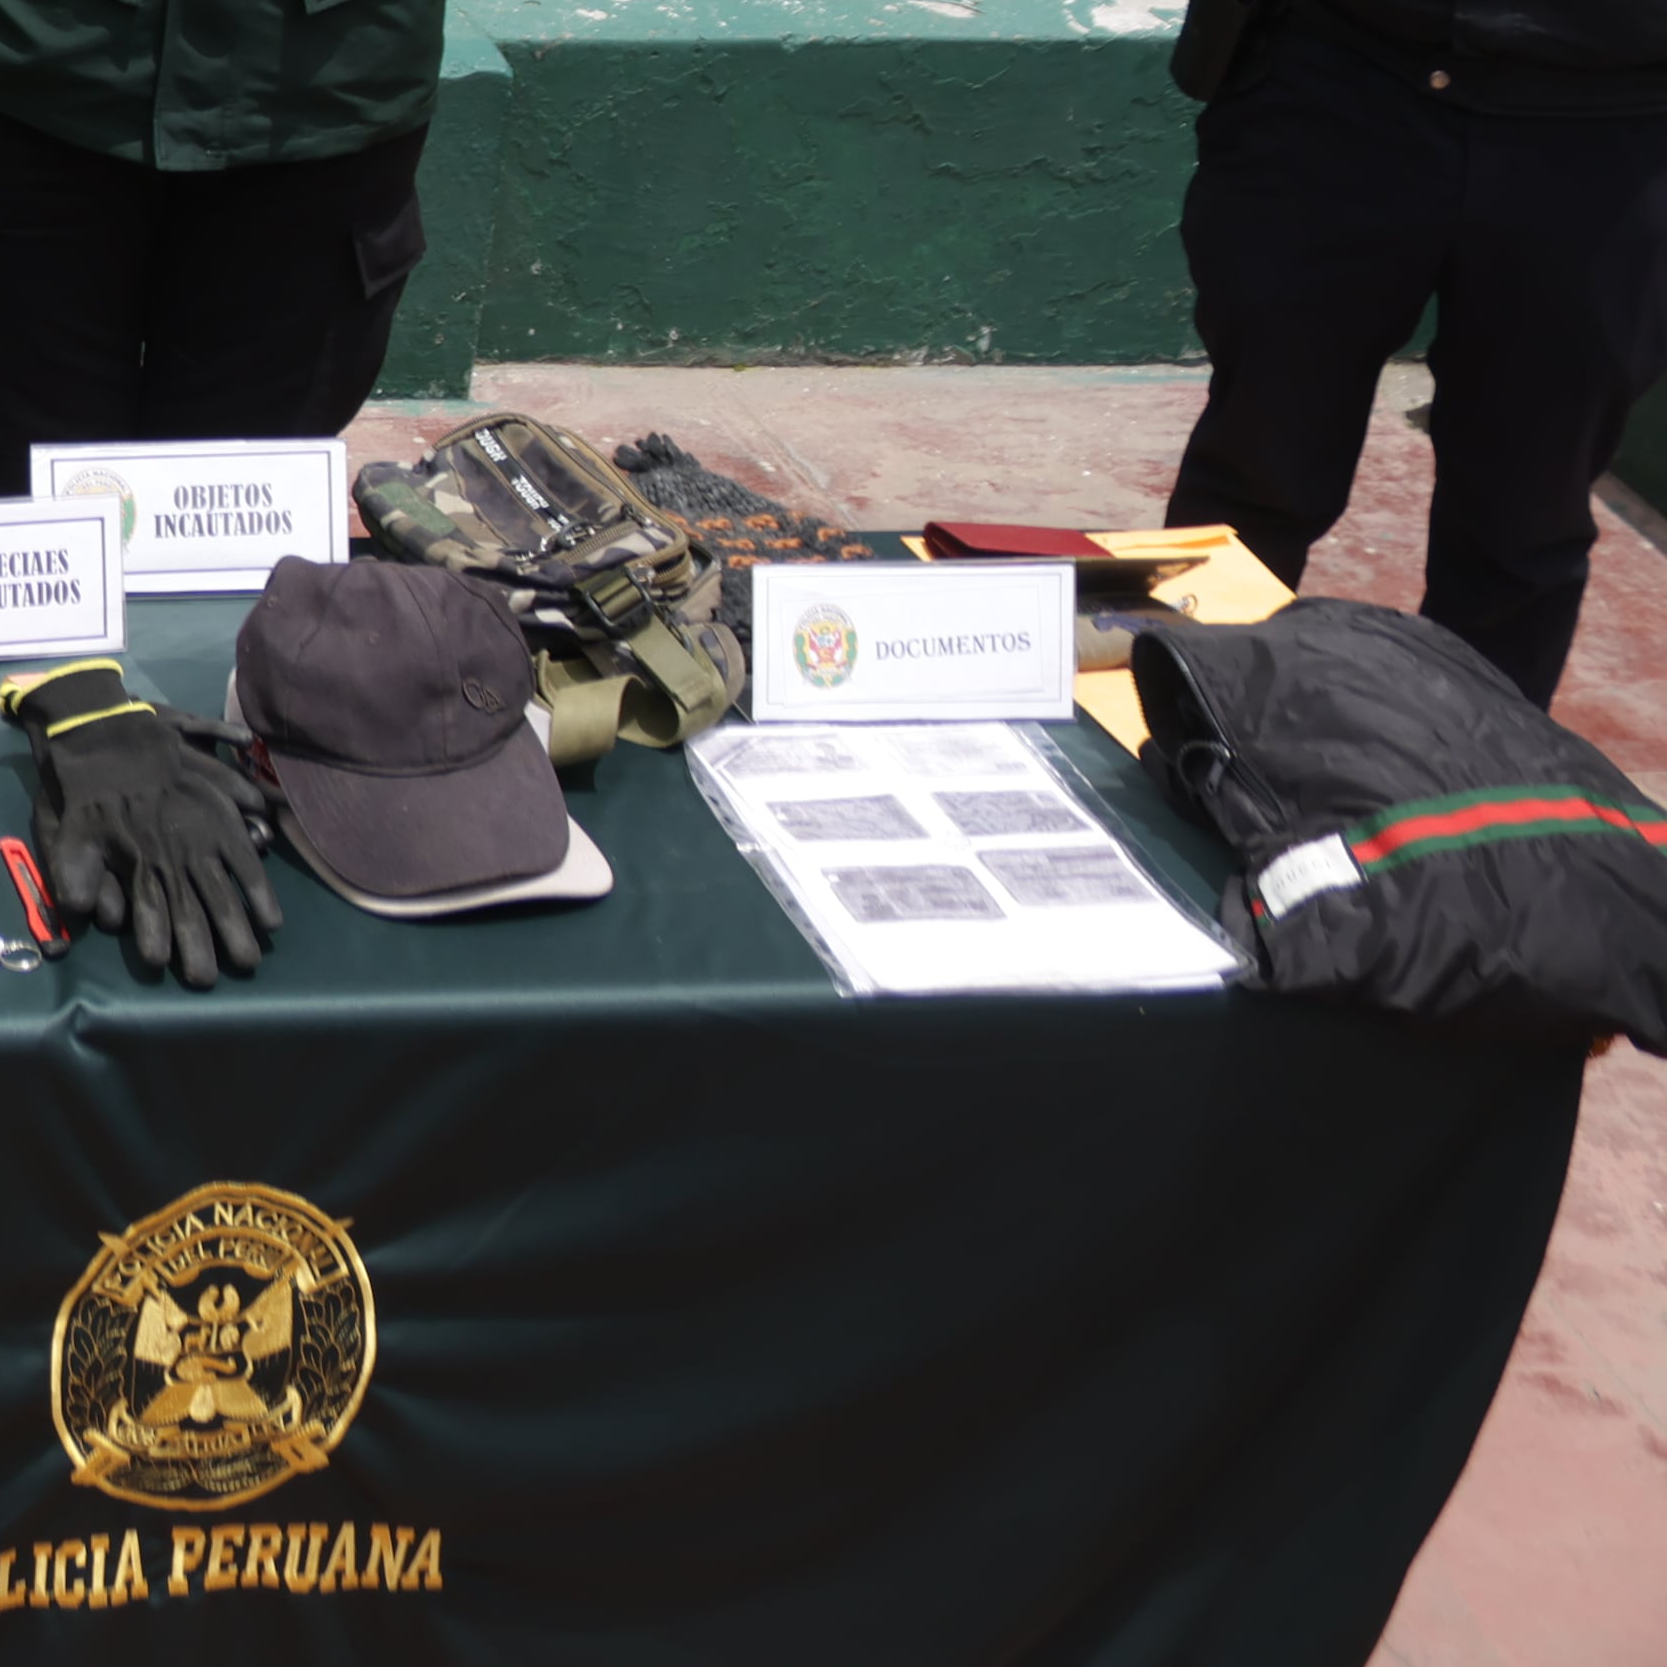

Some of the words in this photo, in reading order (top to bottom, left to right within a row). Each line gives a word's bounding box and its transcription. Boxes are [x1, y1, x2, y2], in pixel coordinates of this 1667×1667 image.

[173, 484, 274, 510] OBJETOS
[154, 511, 293, 539] INCAUTADOS
[875, 632, 1032, 661] DOCUMENTOS
[168, 1521, 443, 1596] PERUANA
